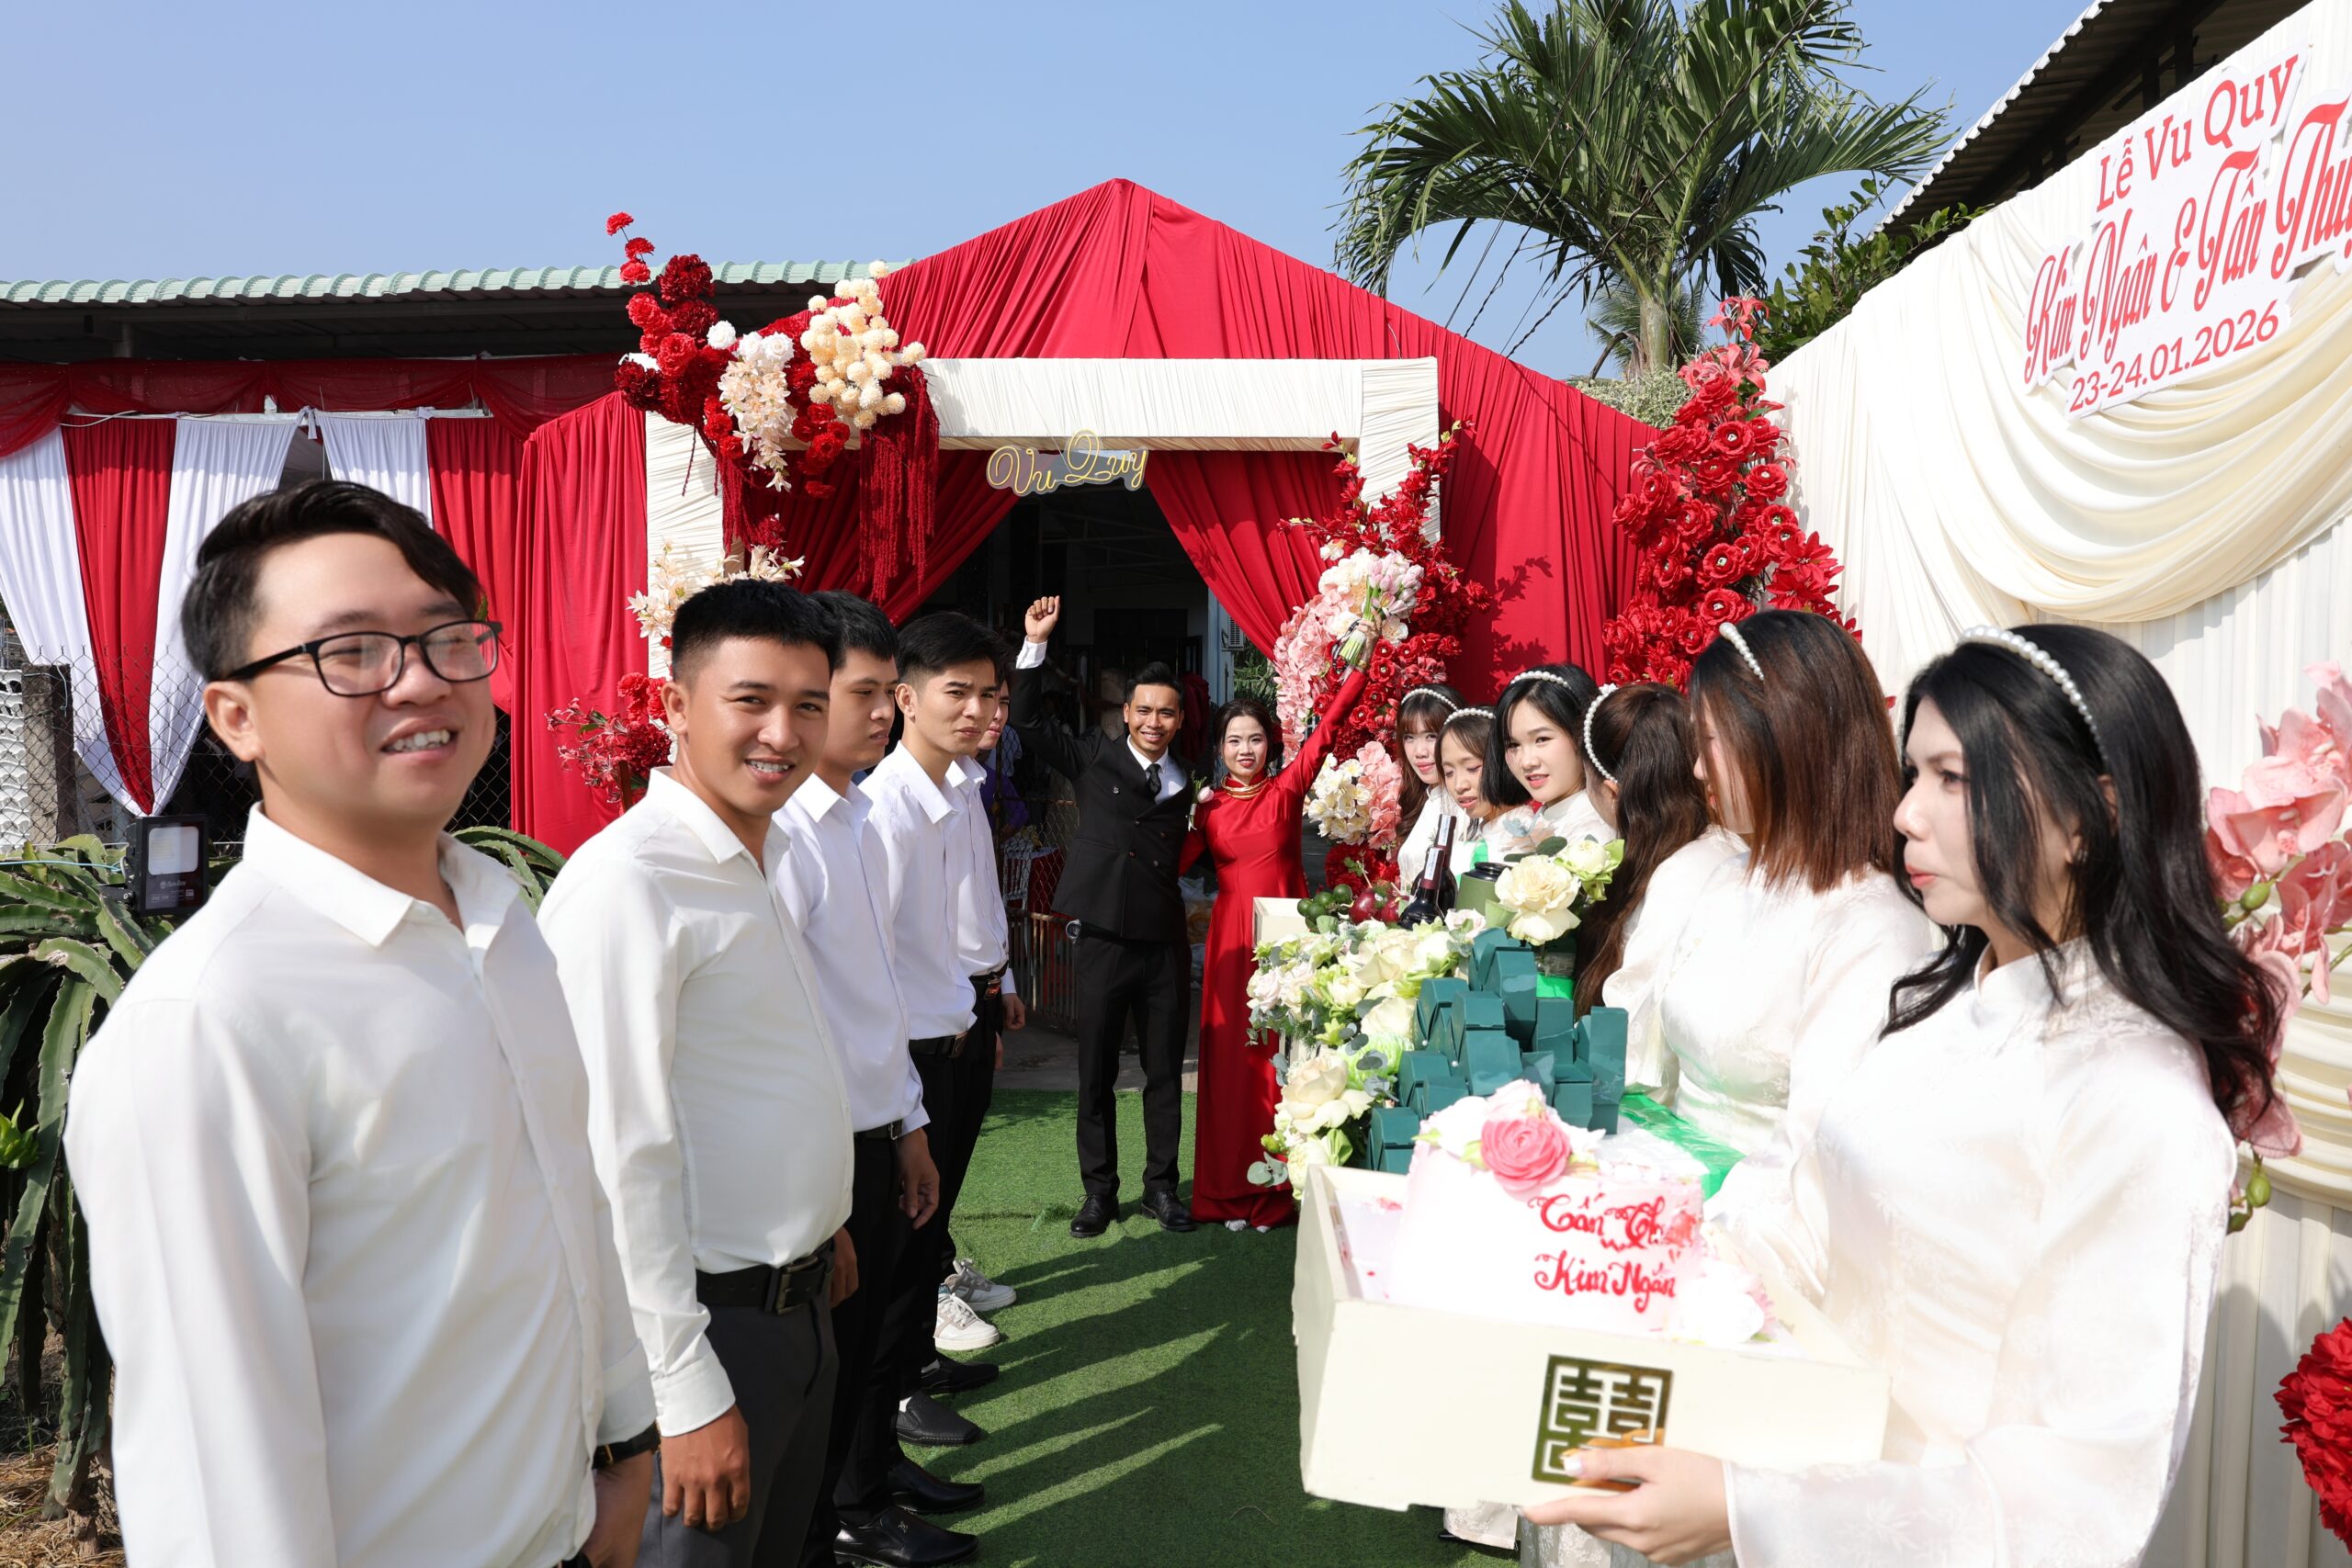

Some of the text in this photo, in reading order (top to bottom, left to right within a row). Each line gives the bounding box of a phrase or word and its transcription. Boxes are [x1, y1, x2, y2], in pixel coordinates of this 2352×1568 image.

[2096, 54, 2299, 212] Lễ Vu Quy
[2024, 245, 2078, 384] Kim
[2079, 208, 2158, 365] Ngân
[2193, 141, 2267, 312] Tấn
[2069, 299, 2279, 412] 23-24.01.2026
[987, 429, 1147, 494] Vu Quy
[1534, 1249, 1609, 1296] Kim
